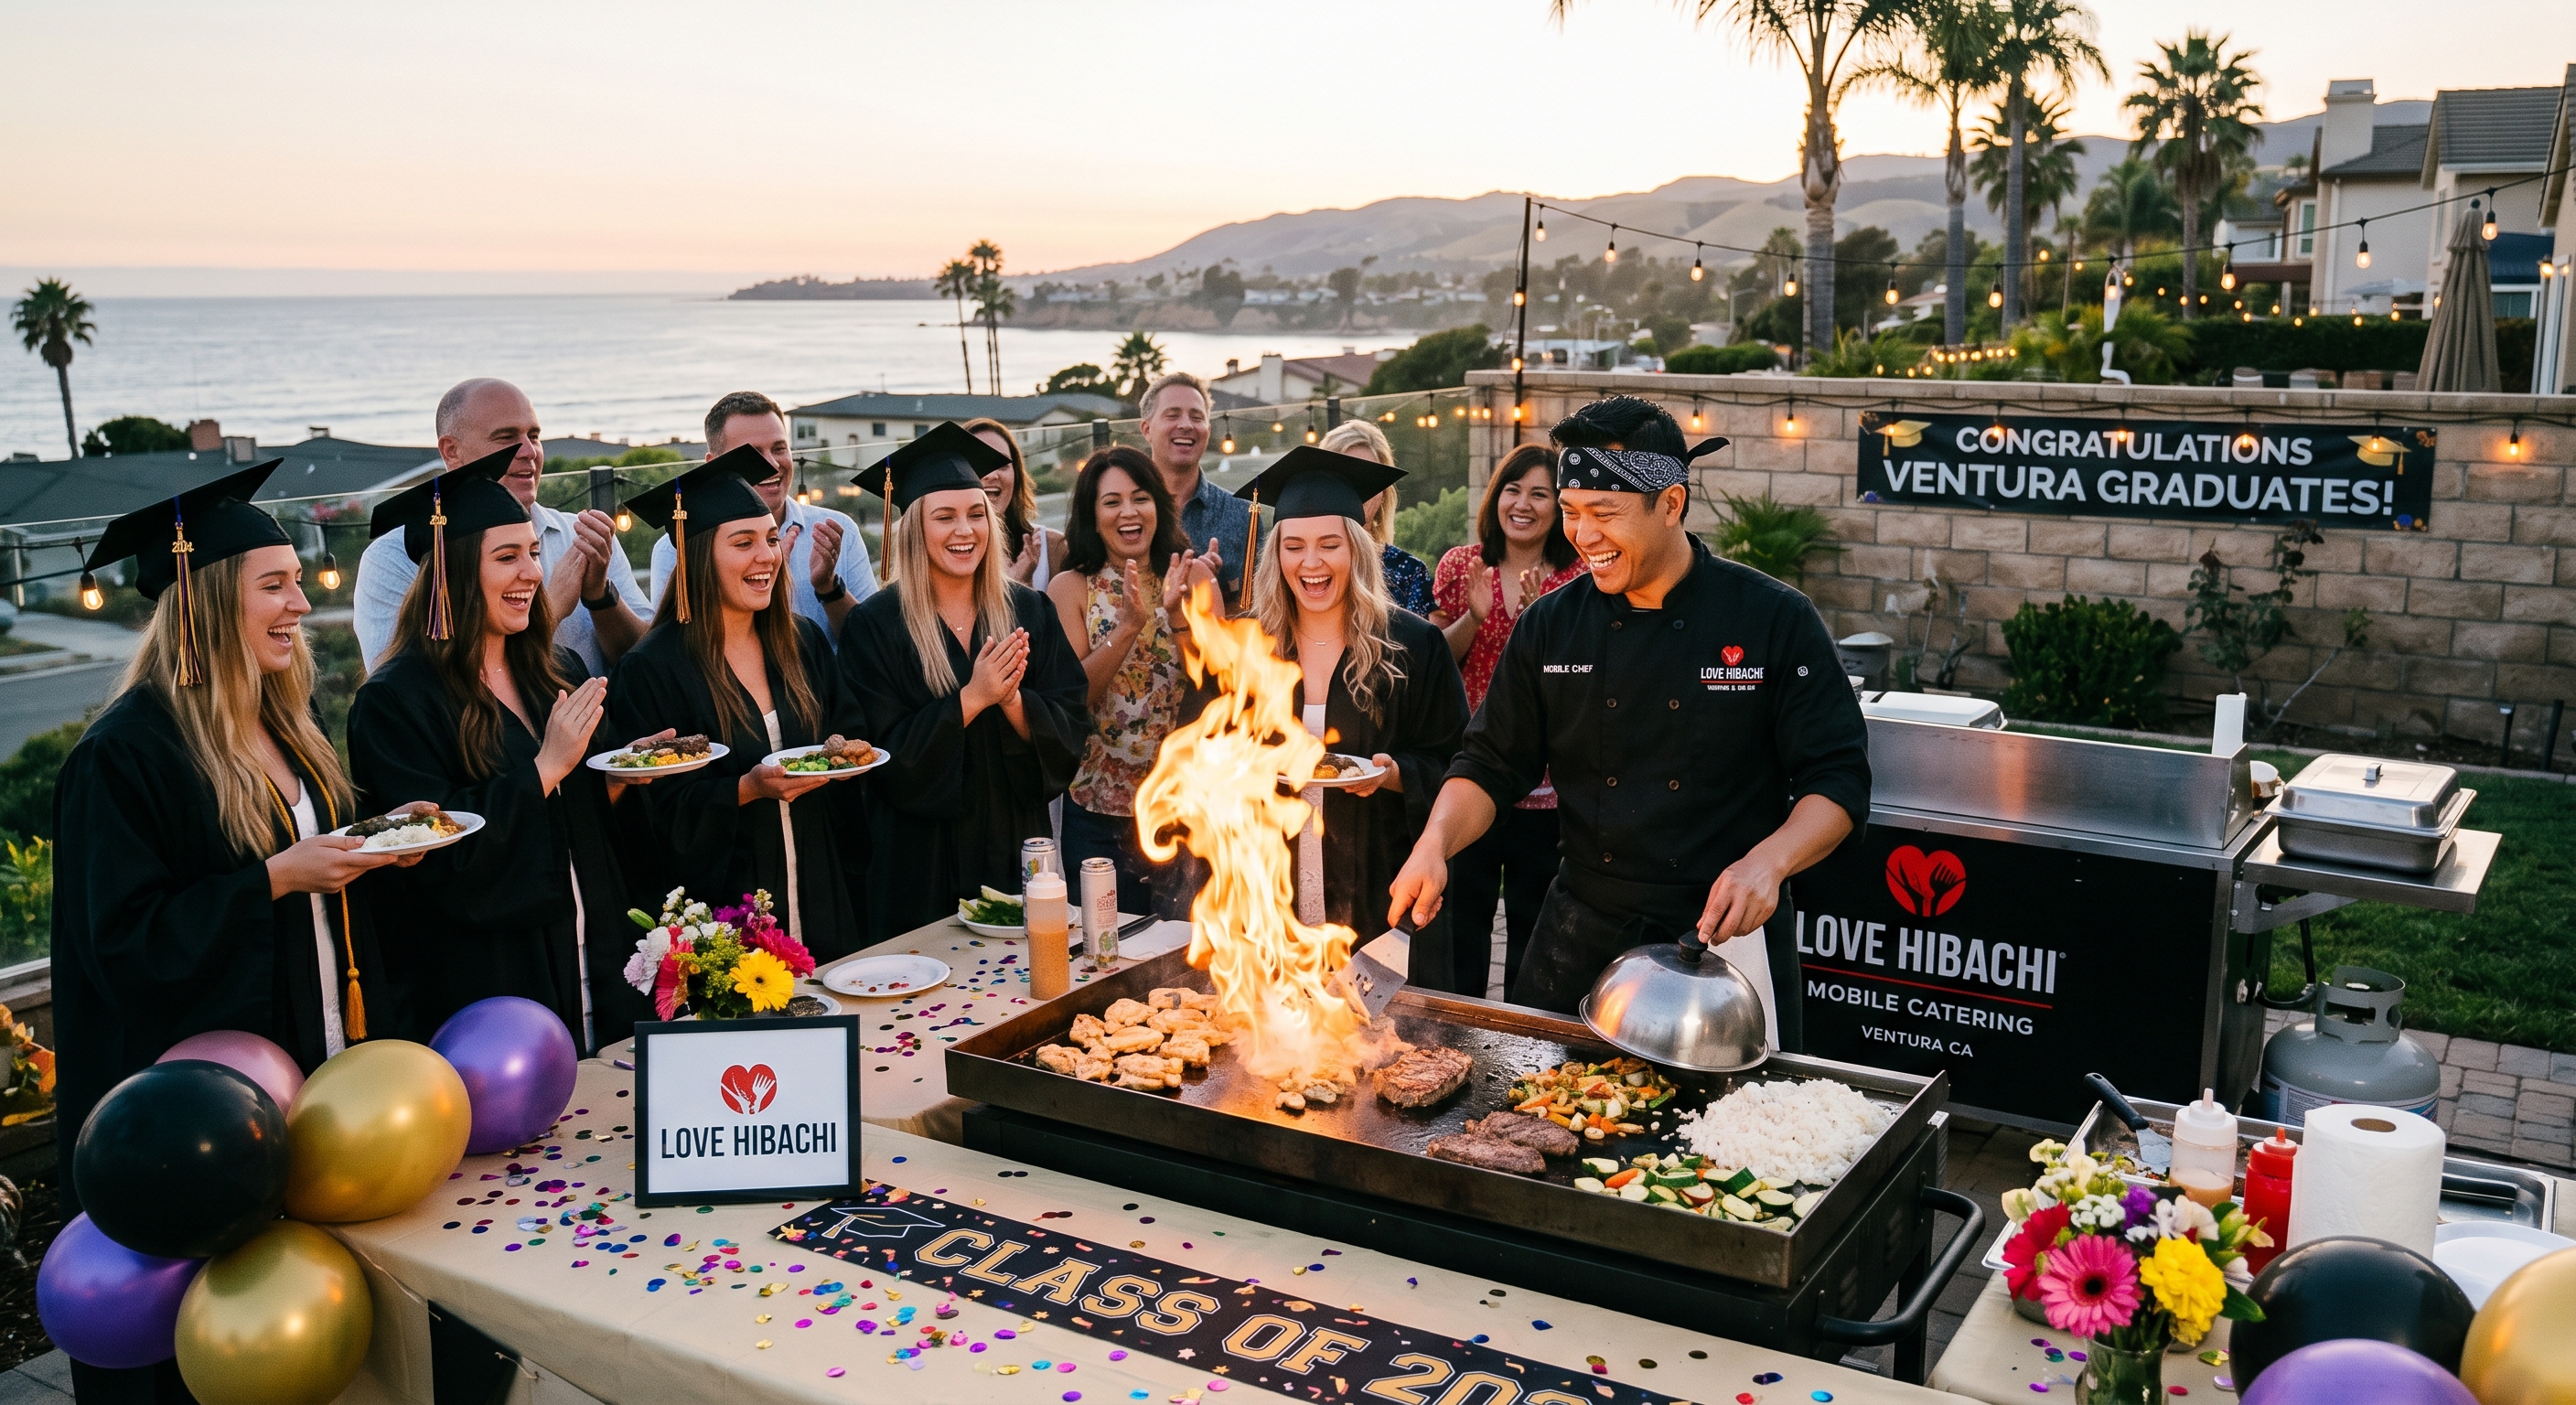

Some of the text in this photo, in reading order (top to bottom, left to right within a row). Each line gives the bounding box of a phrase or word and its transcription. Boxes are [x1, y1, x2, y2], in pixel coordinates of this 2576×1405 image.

[1955, 426, 2313, 467] CONGRATULATIONS
[1883, 459, 2394, 516] VENTURA GRADUATES!
[1572, 664, 1594, 673] CHEF
[1701, 667, 1724, 680] LOVE
[1796, 910, 1886, 967] LOVE
[1807, 980, 2034, 1035] MOBILE CATERING
[1862, 1024, 1974, 1057] VENTURA CA
[661, 1122, 836, 1158] LOVE HIBACHI
[915, 1228, 1594, 1405] CLASS OF 20
